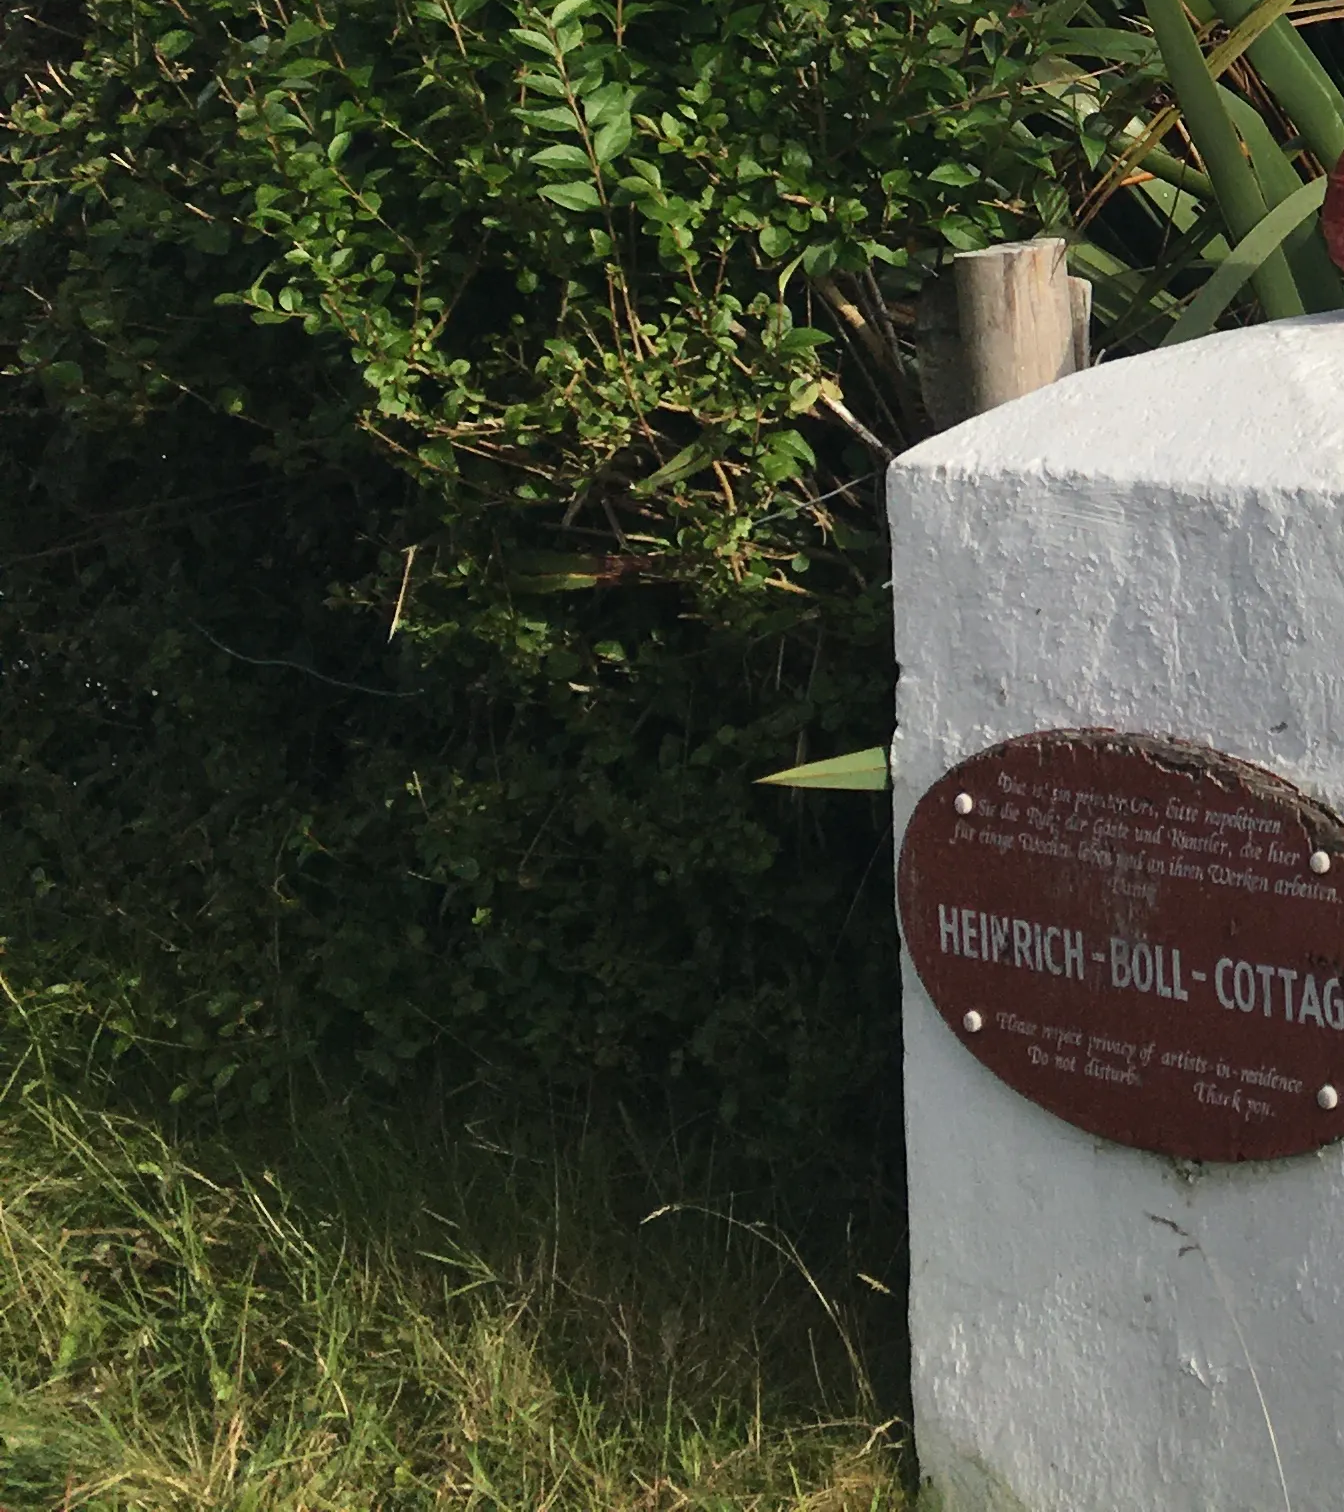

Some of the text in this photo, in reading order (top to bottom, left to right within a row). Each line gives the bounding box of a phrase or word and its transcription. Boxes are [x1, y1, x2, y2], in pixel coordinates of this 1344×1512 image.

[1135, 825, 1164, 845] und
[1267, 840, 1301, 866] hier
[1027, 1042, 1050, 1066] Do
[1055, 1054, 1076, 1073] not
[1086, 1033, 1136, 1064] privacy
[1139, 1041, 1156, 1067] of
